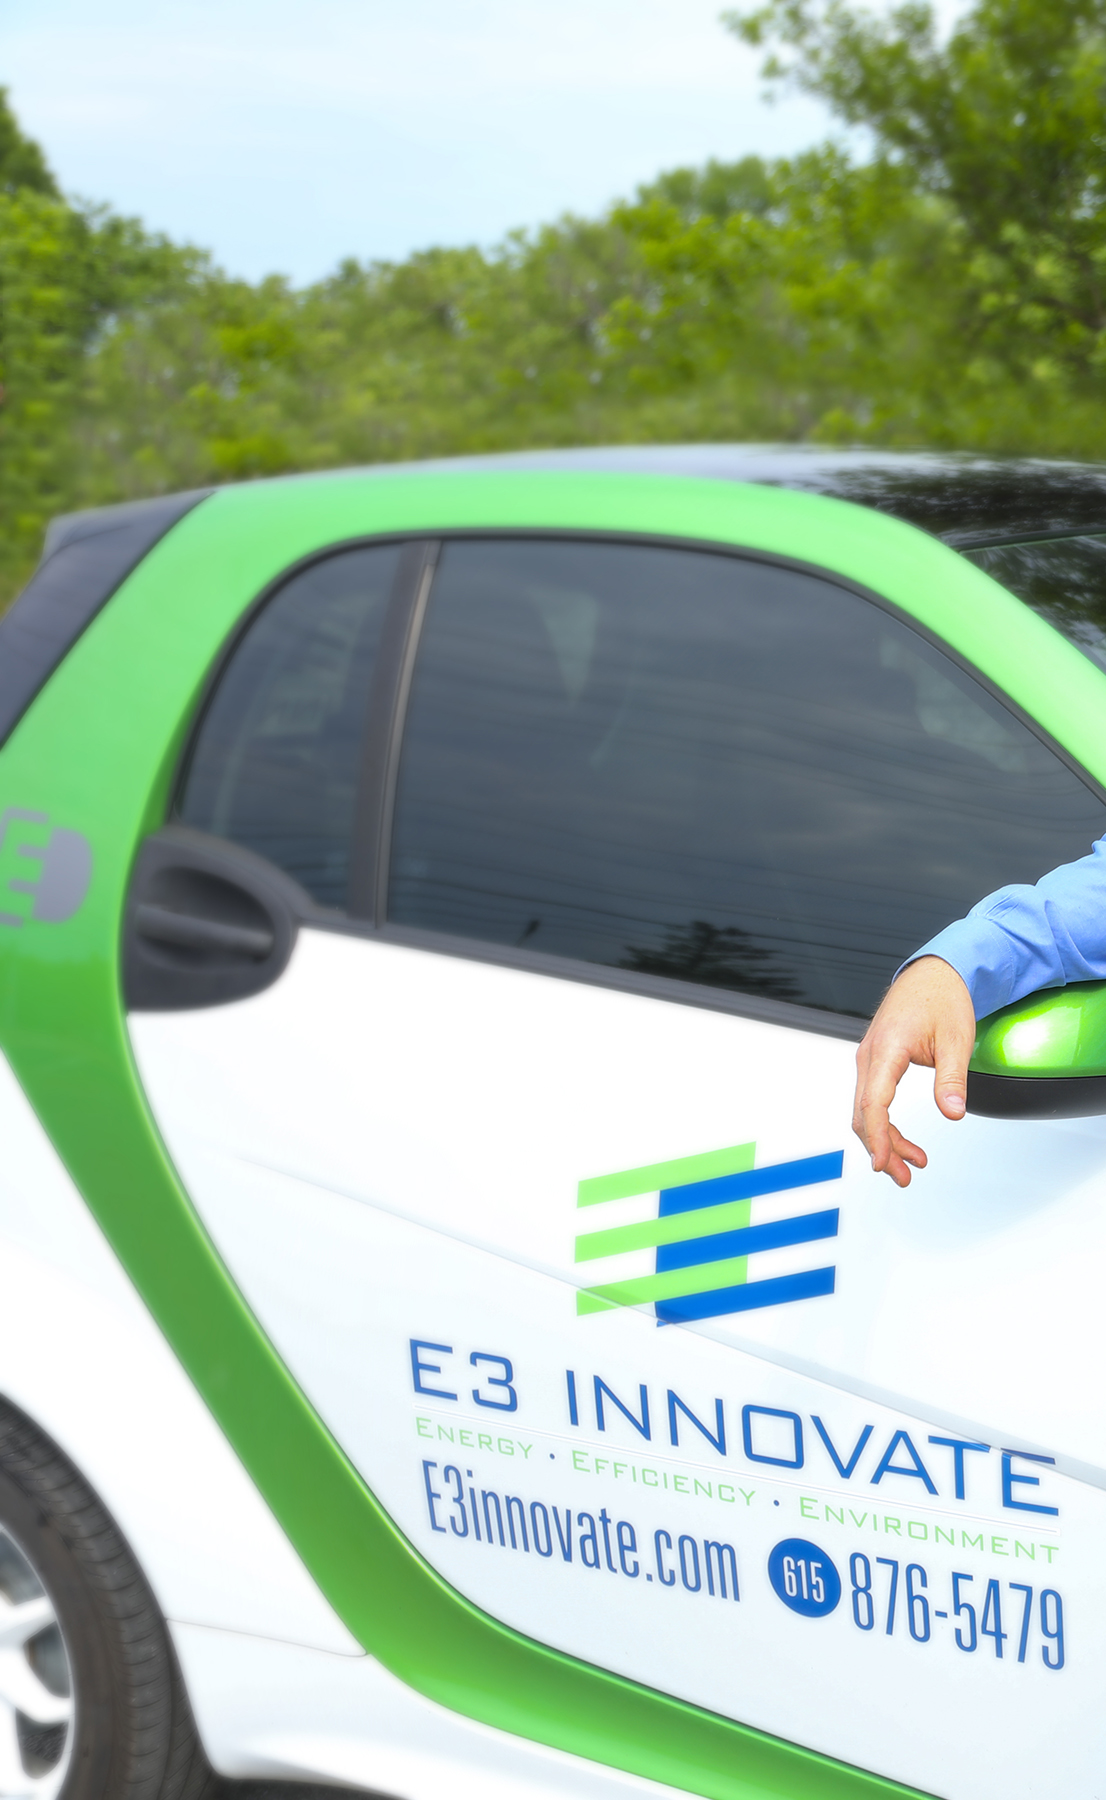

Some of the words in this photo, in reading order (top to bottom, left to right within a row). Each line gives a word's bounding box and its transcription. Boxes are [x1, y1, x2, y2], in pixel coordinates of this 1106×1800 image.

[409, 1338, 518, 1413] E3
[565, 1369, 1060, 1517] INNOVATE
[415, 1416, 534, 1459] ENERGY
[571, 1449, 757, 1507] EFFICIENCY
[799, 1496, 1061, 1565] ENVIRONMENT
[422, 1459, 741, 1603] E3innovate.com
[782, 1555, 826, 1604] 615
[848, 1552, 1066, 1672] 876-5479
